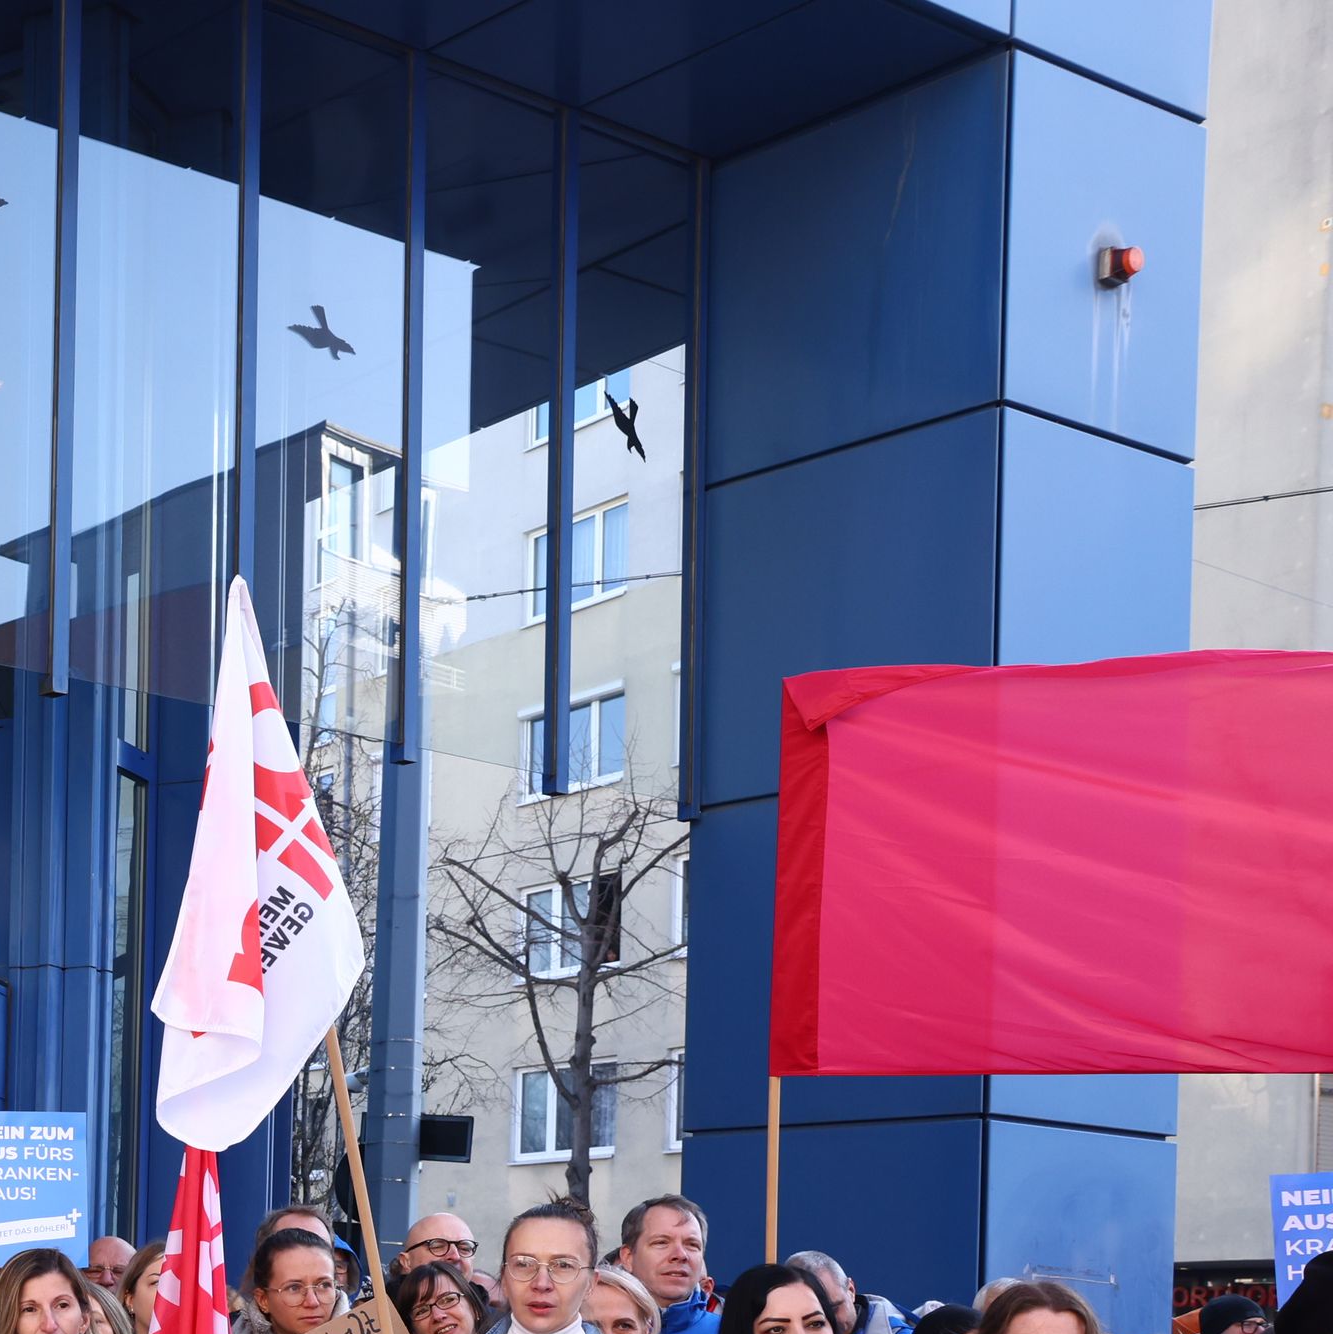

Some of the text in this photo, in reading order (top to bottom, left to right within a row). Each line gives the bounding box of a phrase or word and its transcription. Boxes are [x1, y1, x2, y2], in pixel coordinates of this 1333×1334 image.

[30, 1126, 74, 1141] ZUM
[24, 1144, 74, 1161] FÜRS
[1281, 1189, 1333, 1206] NEI
[15, 1227, 32, 1237] DAS
[33, 1223, 69, 1235] BÖHLER!
